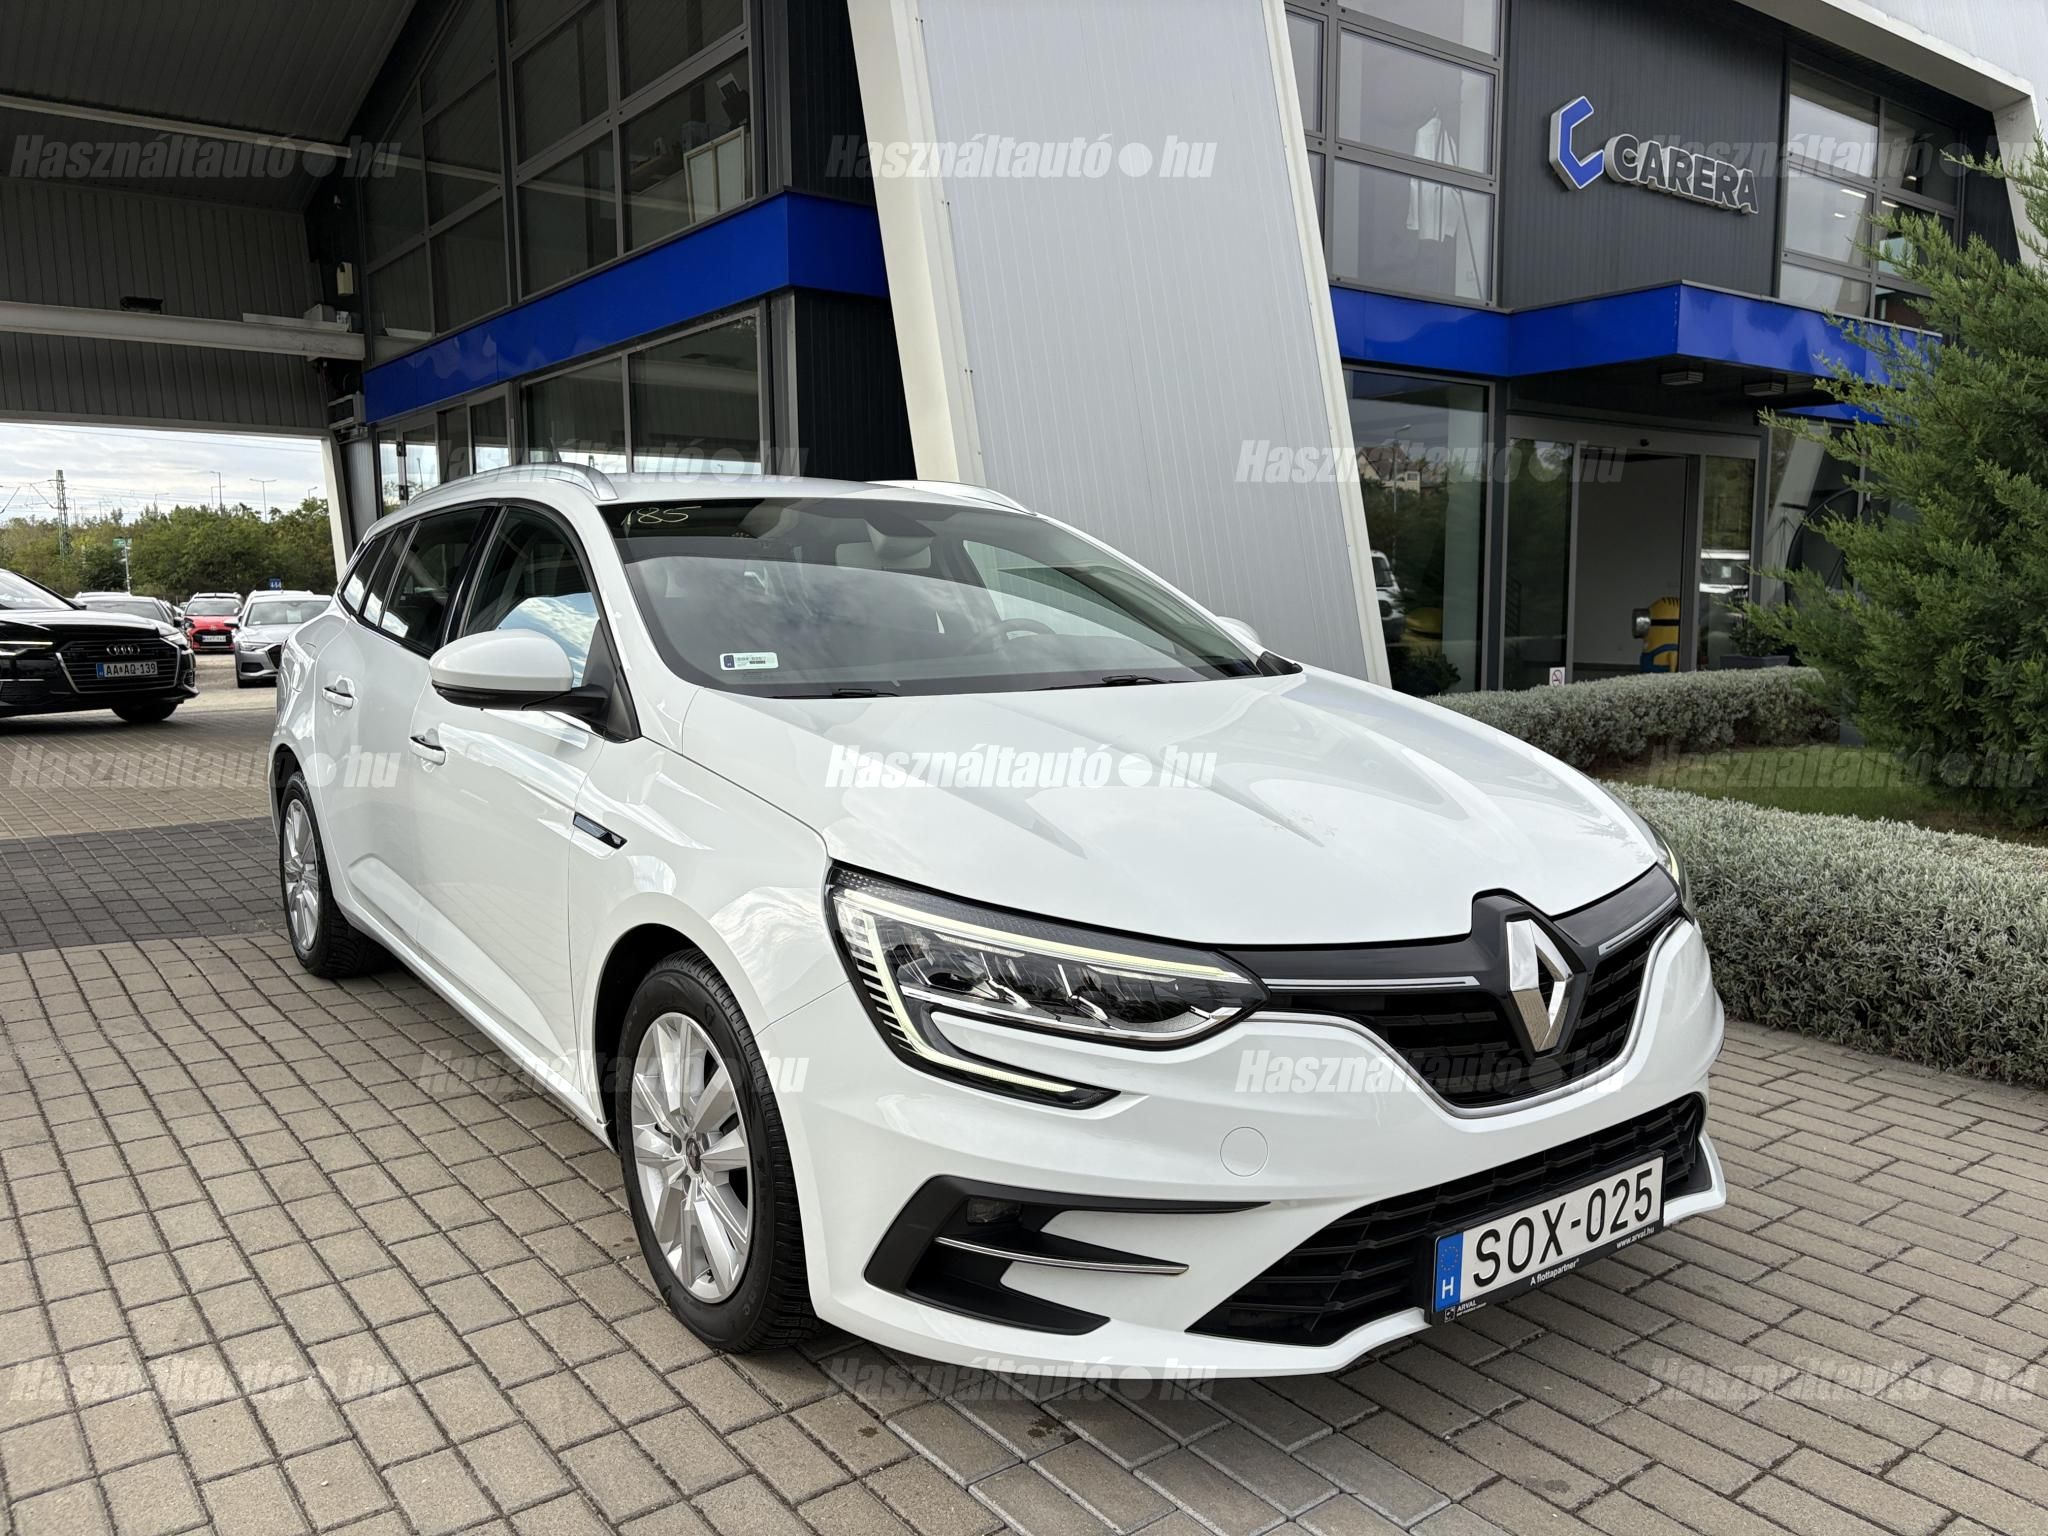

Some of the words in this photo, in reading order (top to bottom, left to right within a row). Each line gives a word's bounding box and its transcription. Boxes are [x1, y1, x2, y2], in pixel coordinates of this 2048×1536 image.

[1604, 133, 1758, 214] CARERA
[620, 505, 702, 525] 185
[1472, 1168, 1653, 1287] SOX-025
[1616, 1226, 1655, 1249] www.arval.hu
[1441, 1276, 1454, 1299] H
[1530, 1276, 1537, 1286] A
[1456, 1299, 1477, 1312] ARVAL
